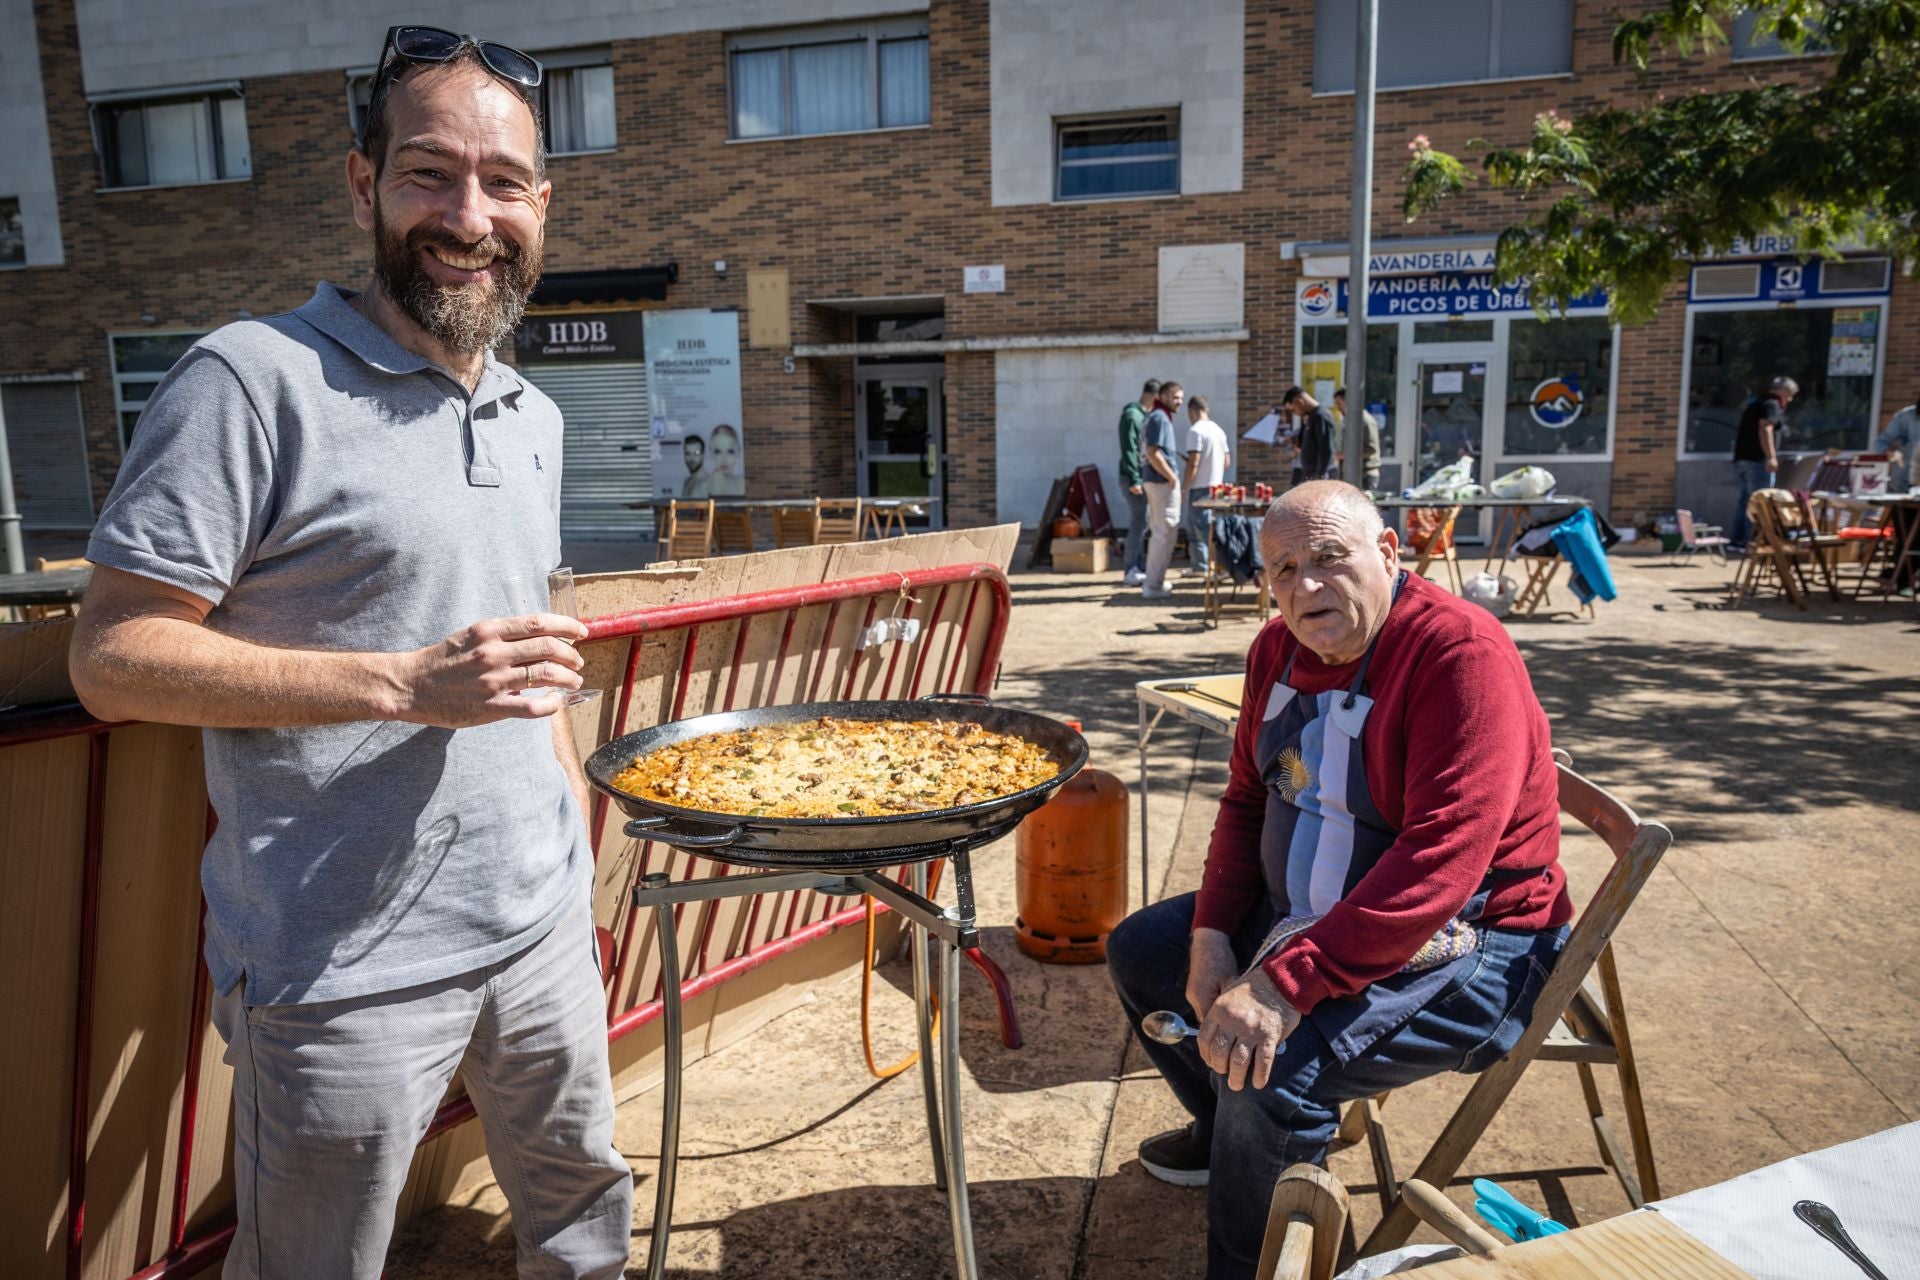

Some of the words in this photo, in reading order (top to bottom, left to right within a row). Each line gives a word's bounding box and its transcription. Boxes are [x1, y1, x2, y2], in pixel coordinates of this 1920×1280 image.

[1751, 235, 1796, 253] URB
[1369, 249, 1476, 271] AVANDERÍA
[1343, 275, 1462, 296] LVANDERÍA
[1389, 296, 1448, 313] PICOS
[1455, 295, 1480, 311] DE
[548, 321, 608, 344] HDB
[677, 339, 706, 350] HDB
[783, 356, 795, 374] 5
